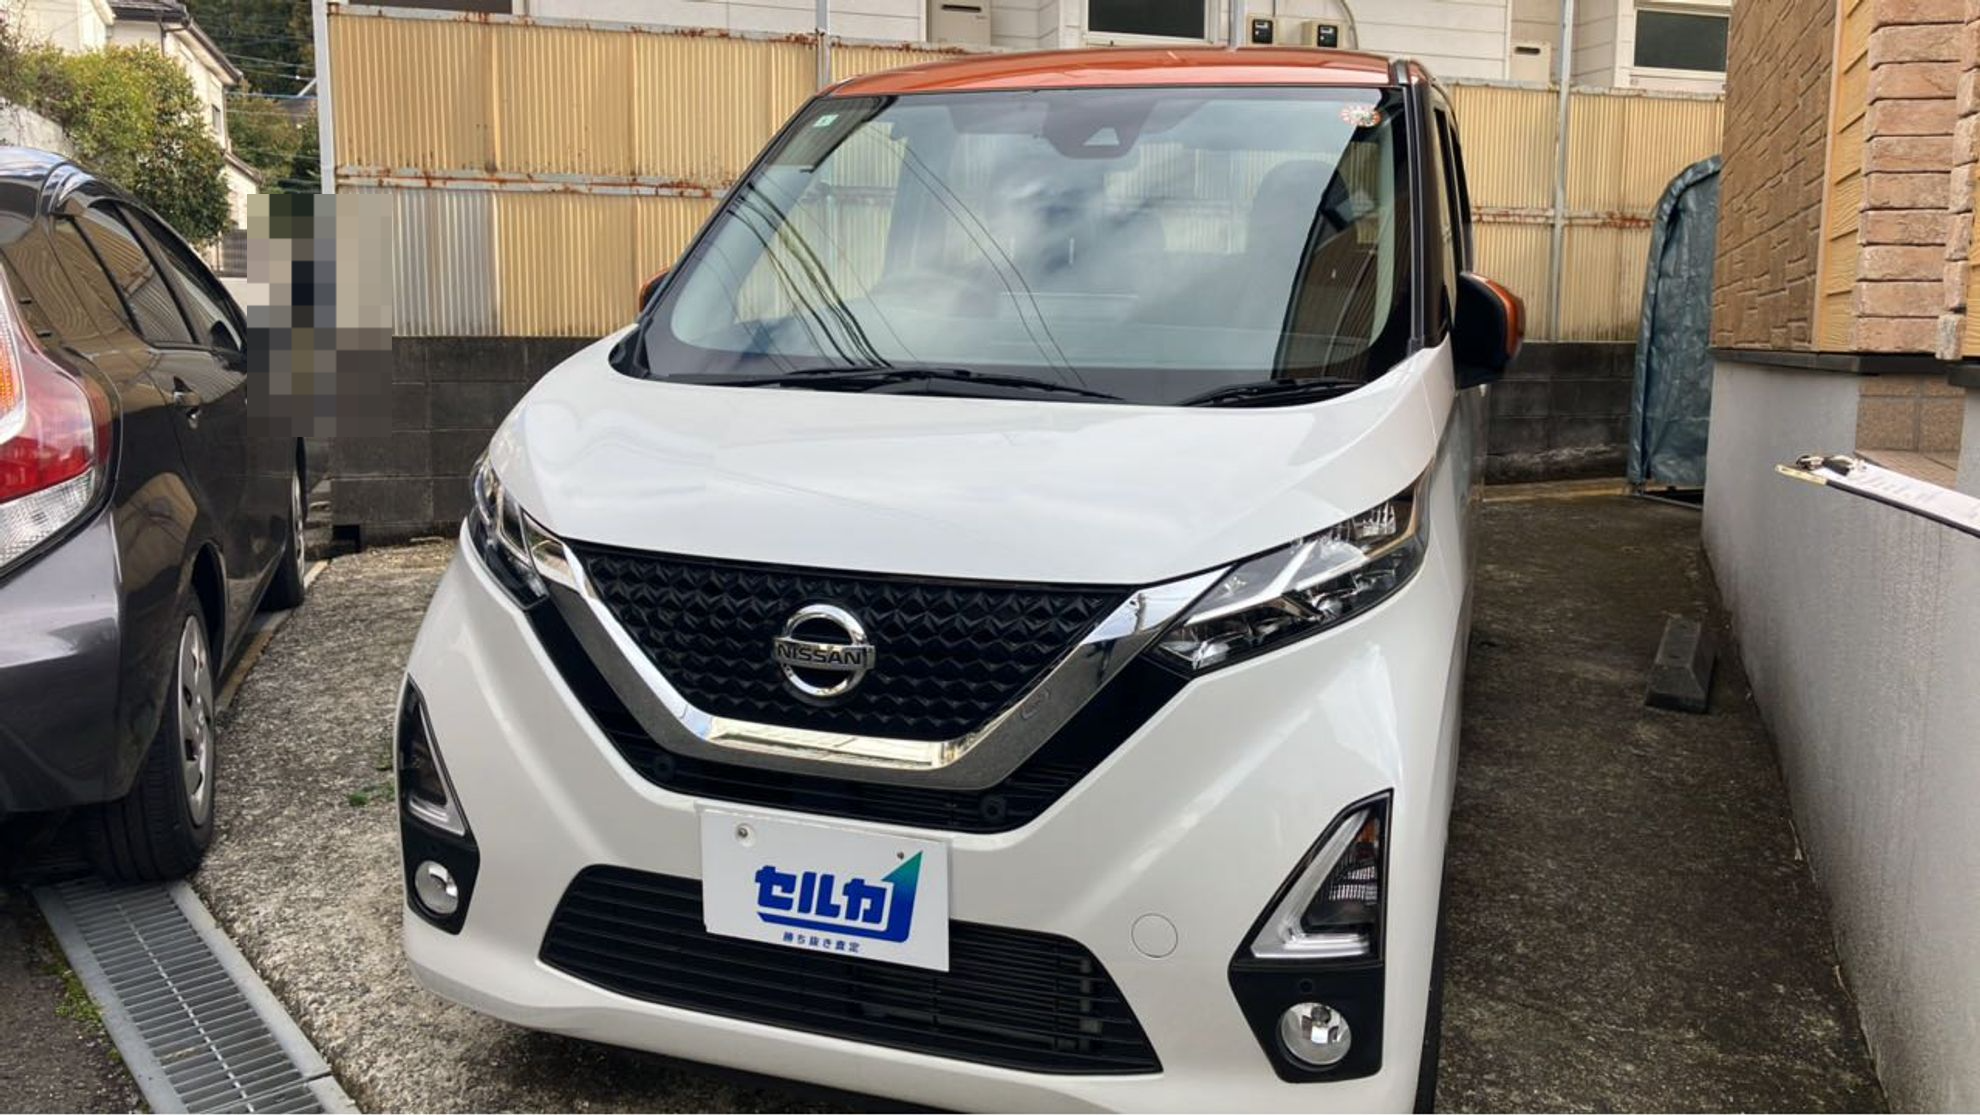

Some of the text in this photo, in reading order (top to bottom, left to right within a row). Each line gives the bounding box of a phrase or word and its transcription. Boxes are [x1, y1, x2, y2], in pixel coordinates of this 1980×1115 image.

[777, 643, 862, 665] NISSAN
[755, 865, 887, 925] セルカ
